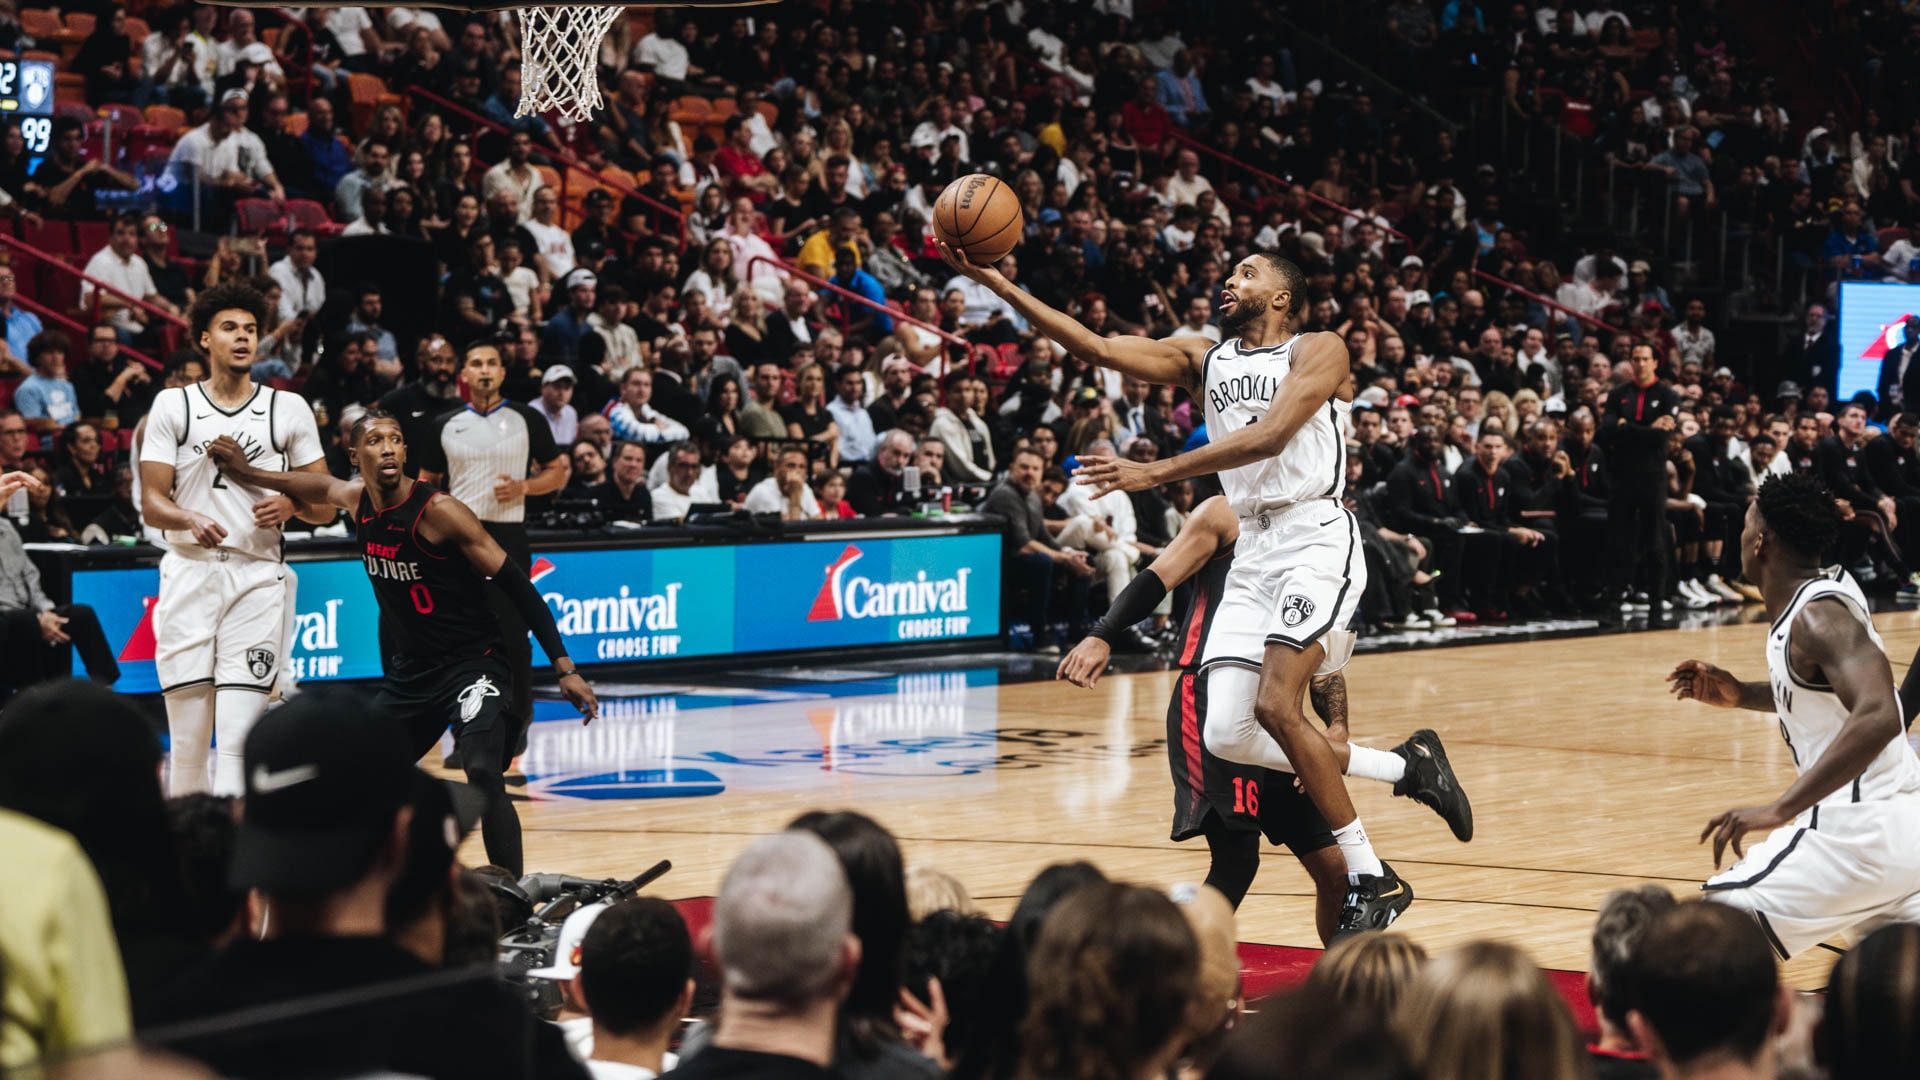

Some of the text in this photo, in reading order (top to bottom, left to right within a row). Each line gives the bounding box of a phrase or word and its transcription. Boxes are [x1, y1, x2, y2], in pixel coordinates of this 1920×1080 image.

[0, 62, 17, 94] 2
[21, 117, 52, 152] 99
[1209, 374, 1278, 413] BROOKLY
[366, 541, 403, 560] HEAT
[362, 553, 423, 582] UTURE
[409, 583, 434, 615] 0
[844, 567, 968, 619] Carnival
[1282, 595, 1314, 616] NETS
[898, 617, 943, 640] CHOOSE
[247, 649, 275, 667] NETS
[597, 636, 649, 660] CHOOSE
[1232, 776, 1259, 817] 16
